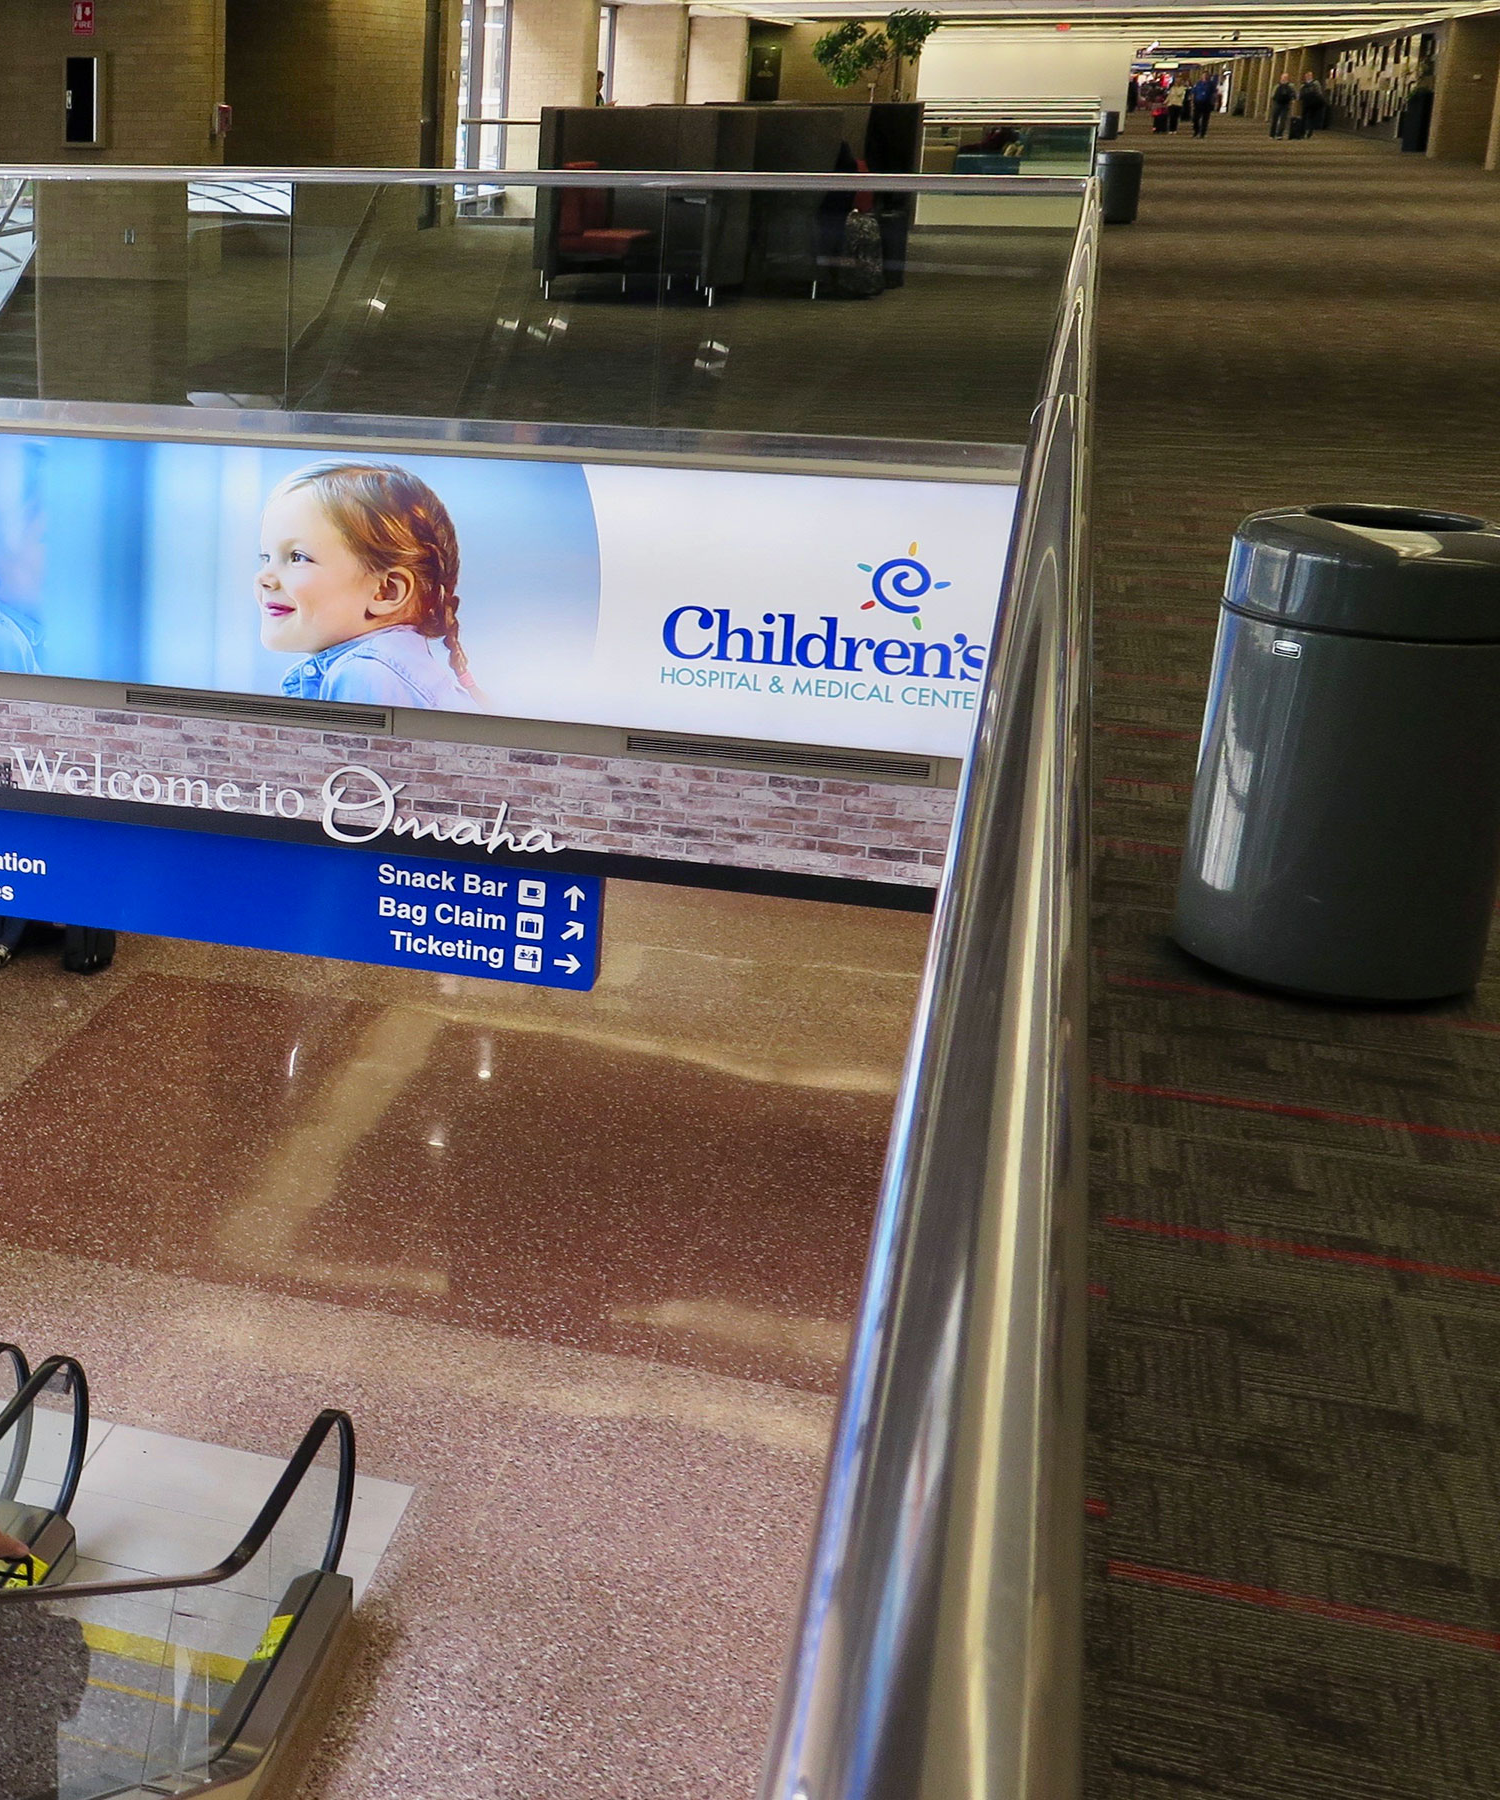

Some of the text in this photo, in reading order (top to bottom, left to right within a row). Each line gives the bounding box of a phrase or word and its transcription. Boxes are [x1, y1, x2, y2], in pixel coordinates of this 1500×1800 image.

[74, 20, 92, 29] FIRE
[662, 605, 986, 683] Children's
[660, 666, 976, 710] HOSPITAL & MEDICAL CENTE
[10, 746, 566, 856] Welcome to Omaha
[377, 863, 508, 898] Snack Bar
[378, 896, 506, 931] Bag Claim
[389, 930, 505, 970] Ticketing
